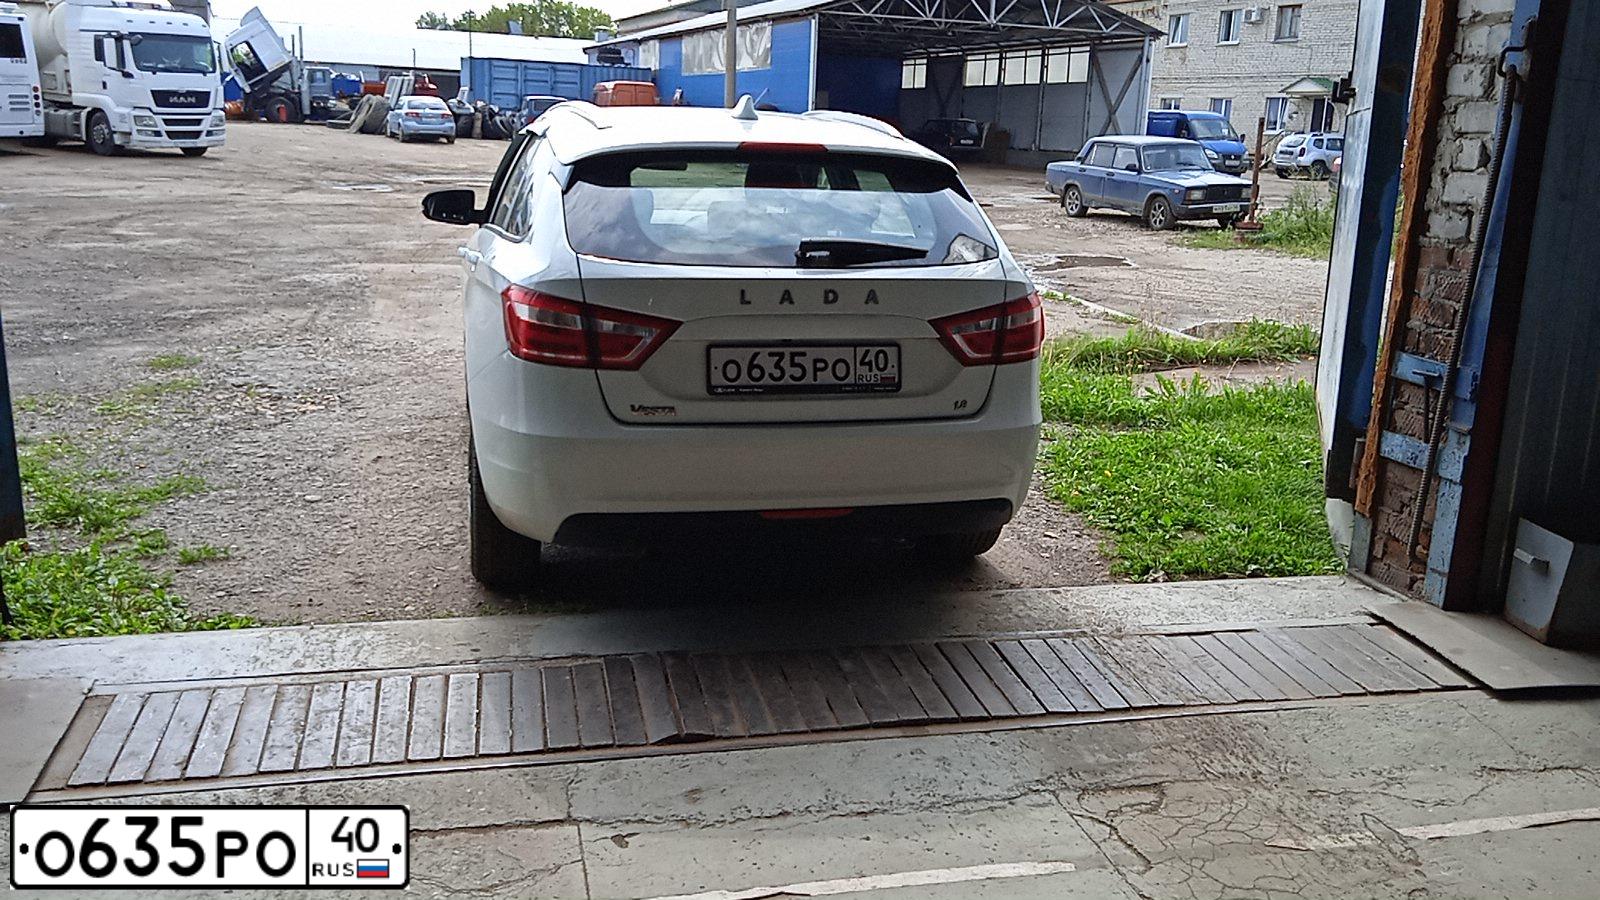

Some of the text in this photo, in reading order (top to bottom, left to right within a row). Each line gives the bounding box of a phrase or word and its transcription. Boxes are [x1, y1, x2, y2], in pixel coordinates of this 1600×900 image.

[740, 289, 879, 304] LADA
[859, 349, 889, 373] 40
[857, 374, 879, 383] RUS
